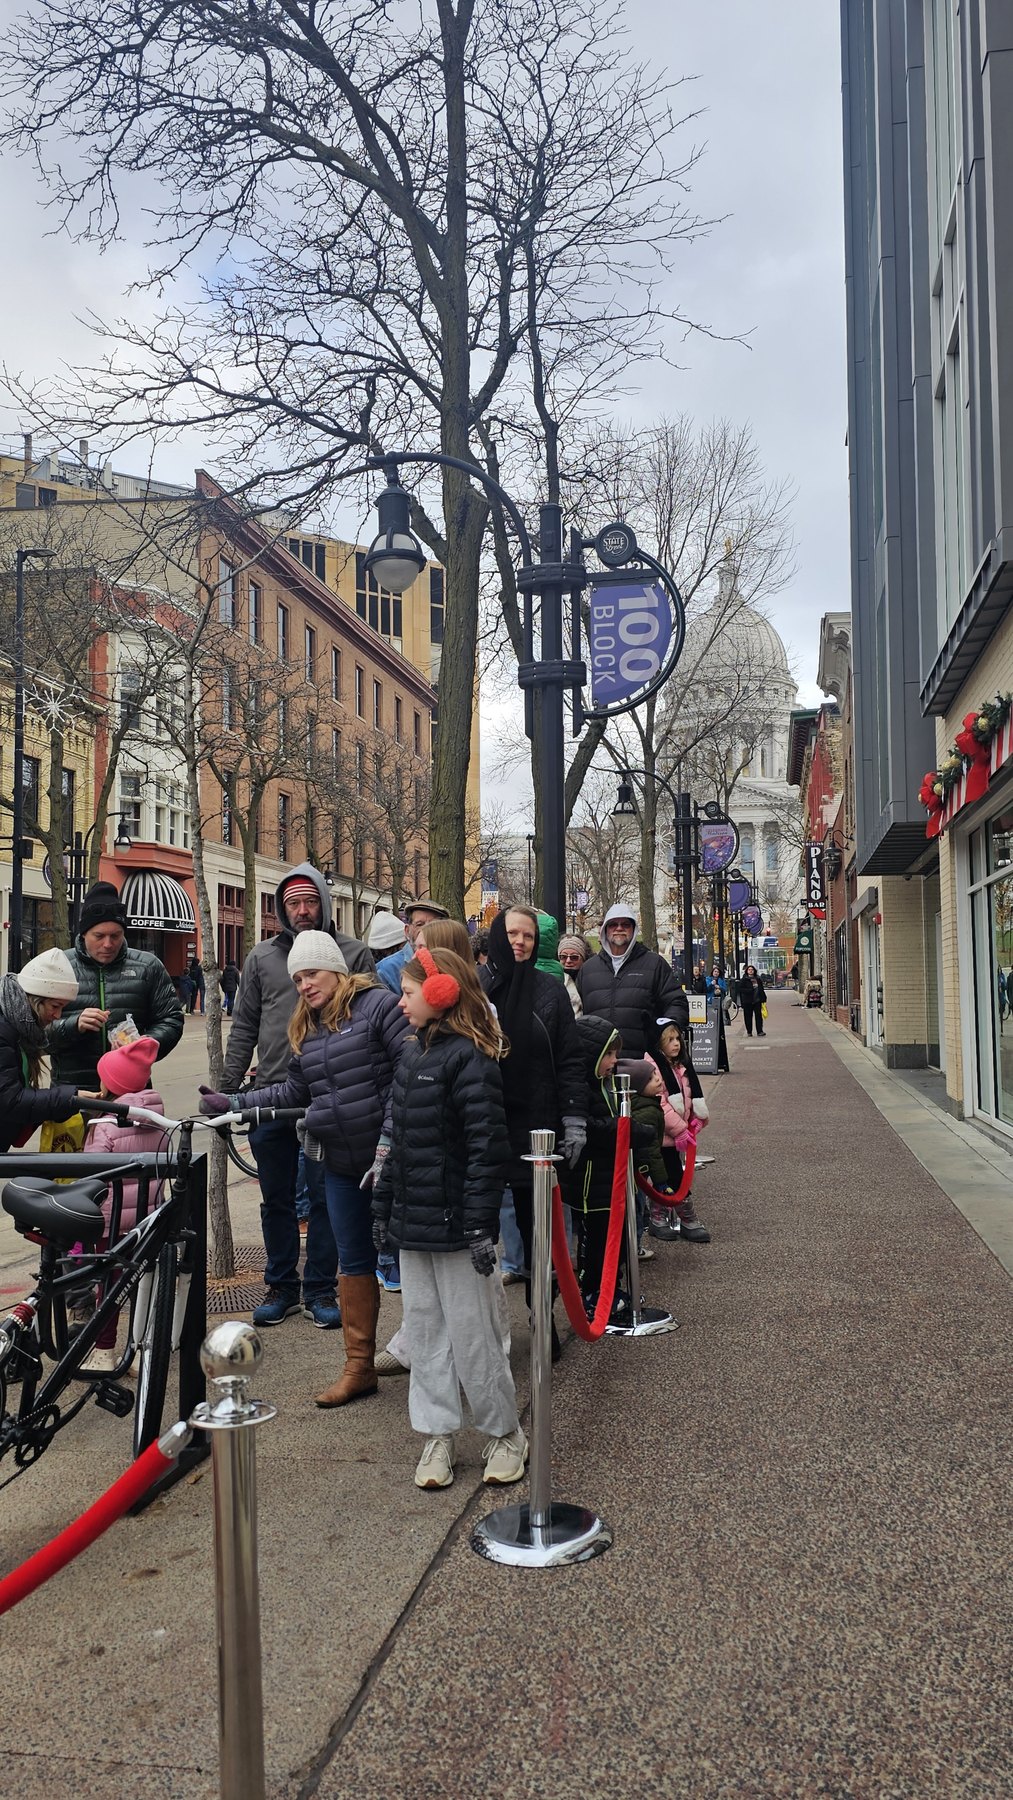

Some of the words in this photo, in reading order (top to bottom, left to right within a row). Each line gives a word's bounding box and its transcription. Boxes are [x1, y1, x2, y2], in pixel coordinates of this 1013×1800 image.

[603, 537, 625, 546] STATE
[593, 605, 616, 684] BLOCK
[619, 587, 660, 682] 100
[810, 847, 821, 900] PIANO
[131, 919, 164, 927] COFFEE
[115, 1283, 131, 1304] WELL
